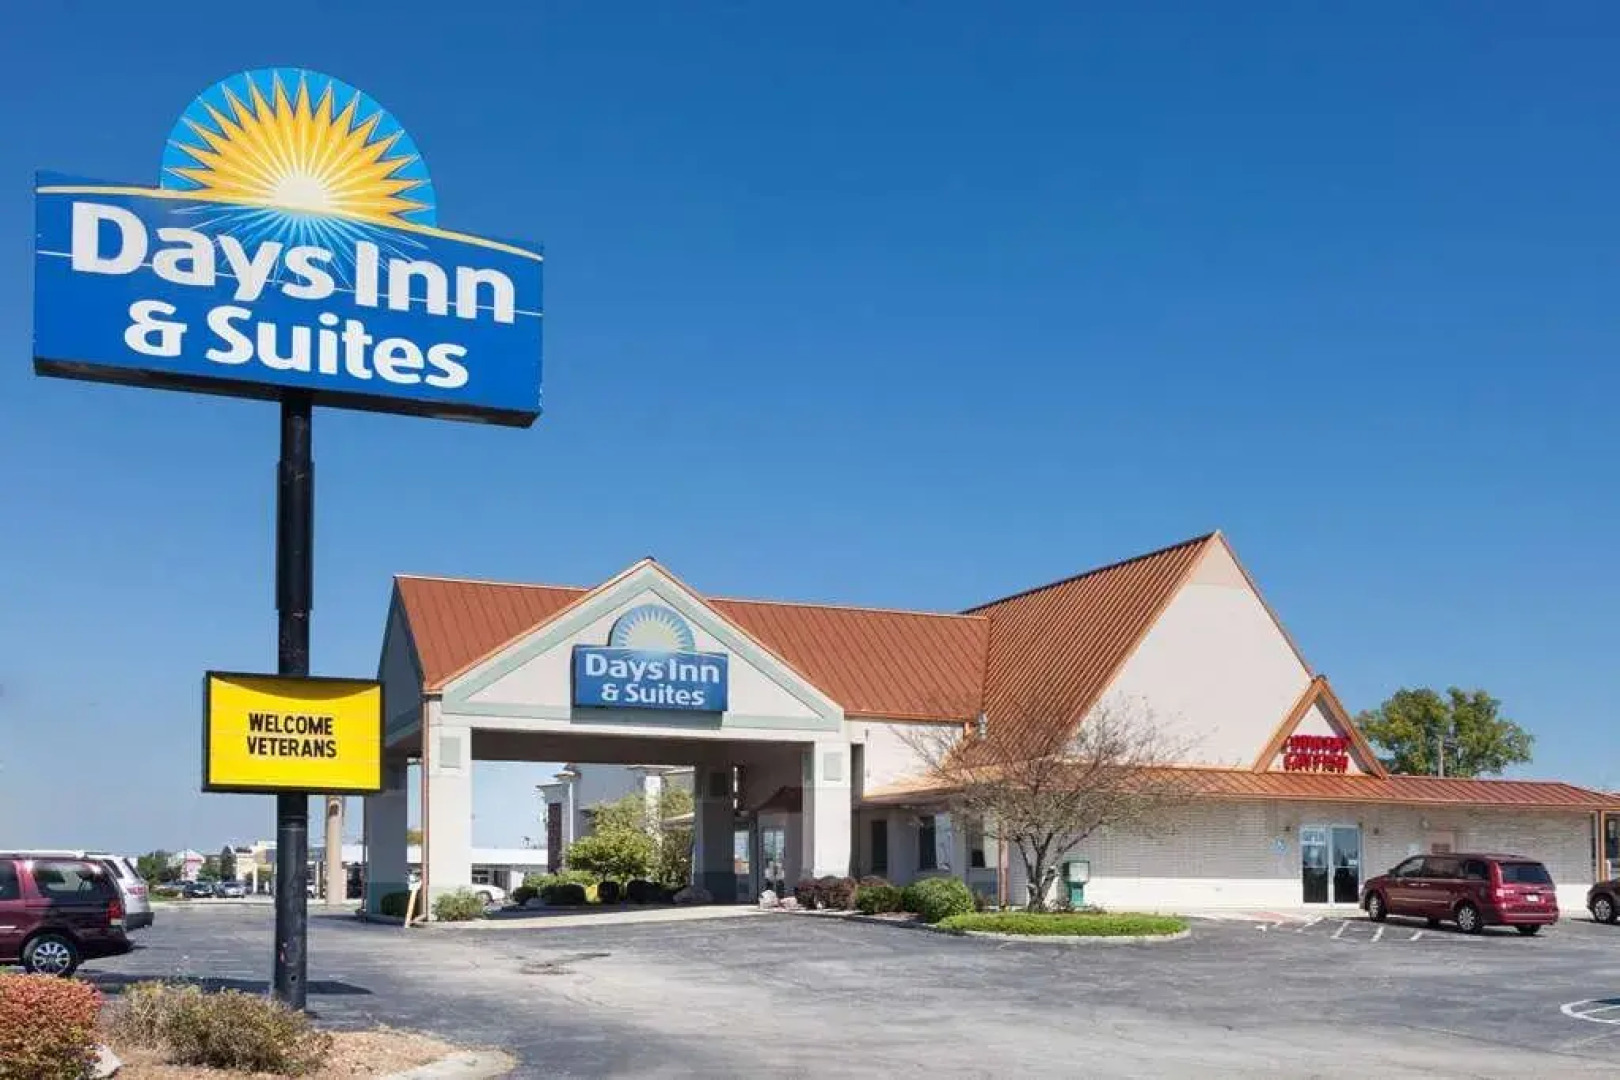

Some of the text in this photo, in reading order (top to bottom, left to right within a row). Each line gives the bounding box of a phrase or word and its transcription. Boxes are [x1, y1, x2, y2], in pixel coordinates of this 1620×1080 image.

[72, 201, 515, 324] Days Inn
[124, 300, 468, 389] & Suites
[585, 653, 720, 683] Days Inn
[601, 683, 704, 706] & Suites
[248, 713, 333, 735] WELCOME
[247, 736, 337, 758] VETERANS
